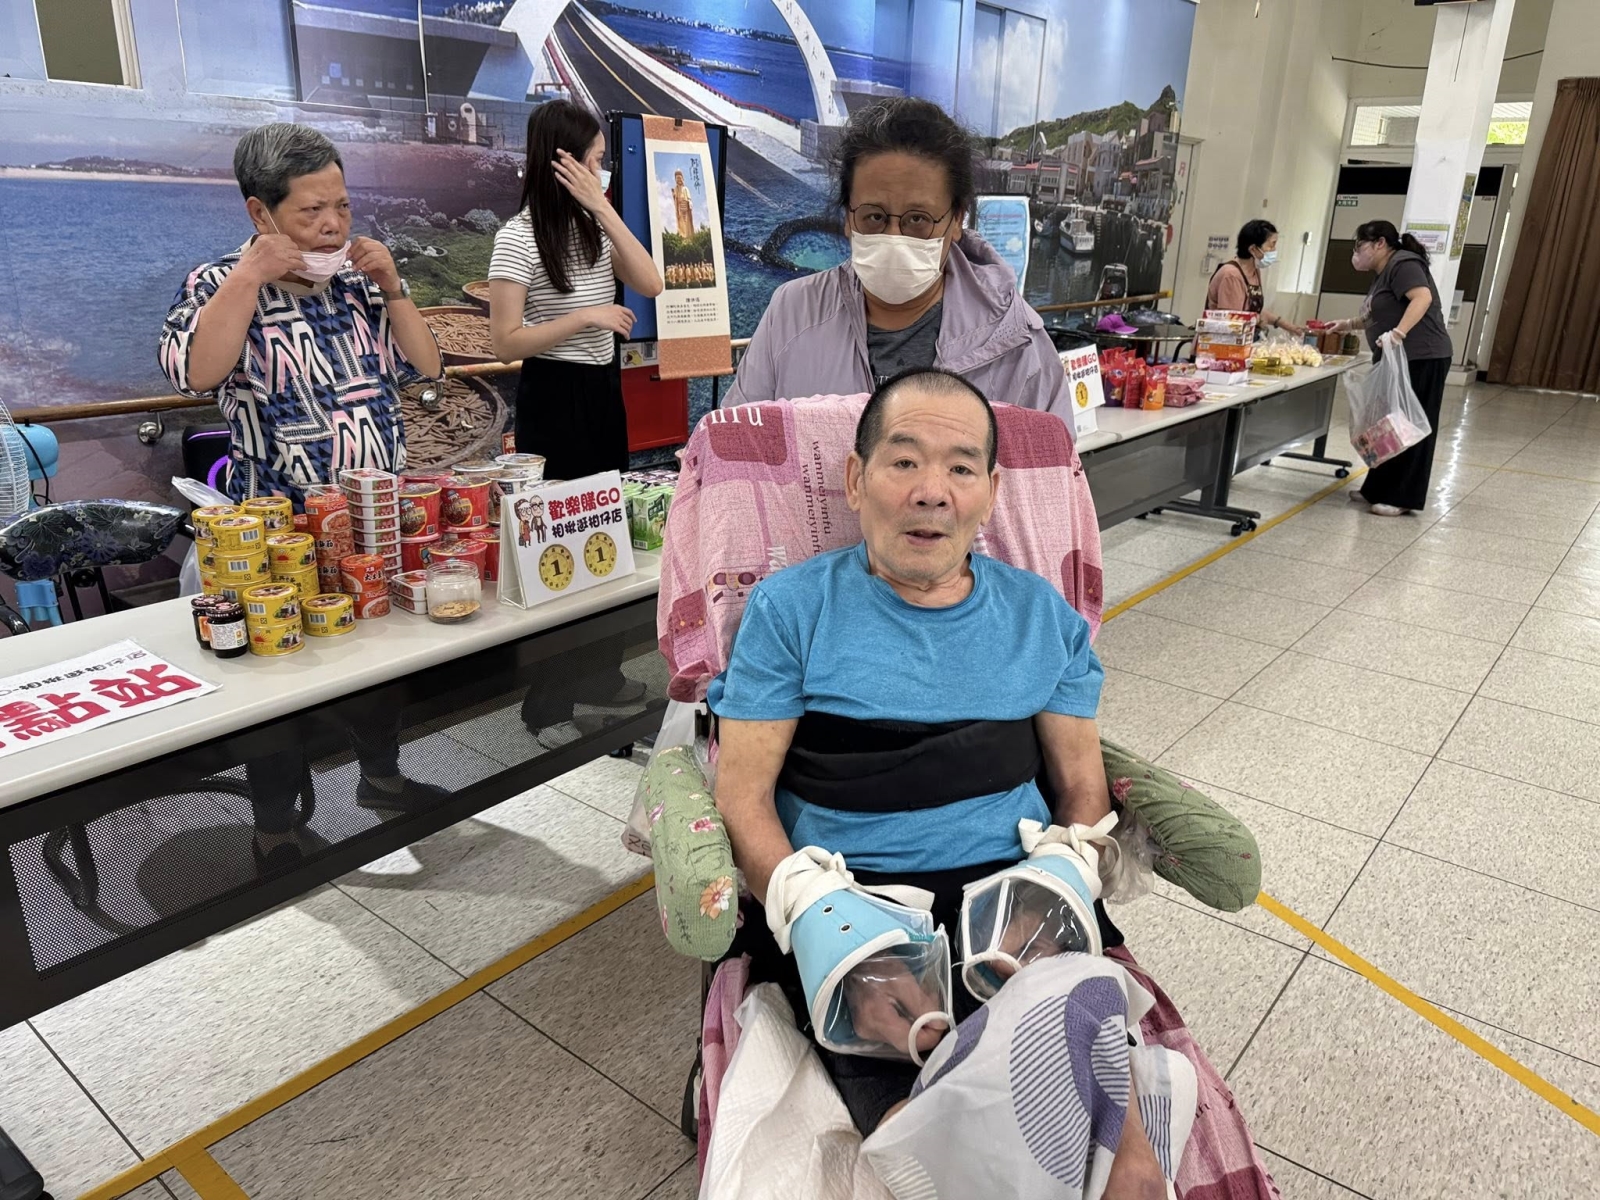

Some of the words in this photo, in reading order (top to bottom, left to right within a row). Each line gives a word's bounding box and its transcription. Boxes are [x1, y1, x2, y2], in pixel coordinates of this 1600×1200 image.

[548, 487, 621, 521] 歡樂購GO
[552, 508, 623, 539] 相揪逛柑仔店
[550, 559, 564, 577] 1
[594, 546, 607, 564] 1
[0, 663, 203, 749] 點站
